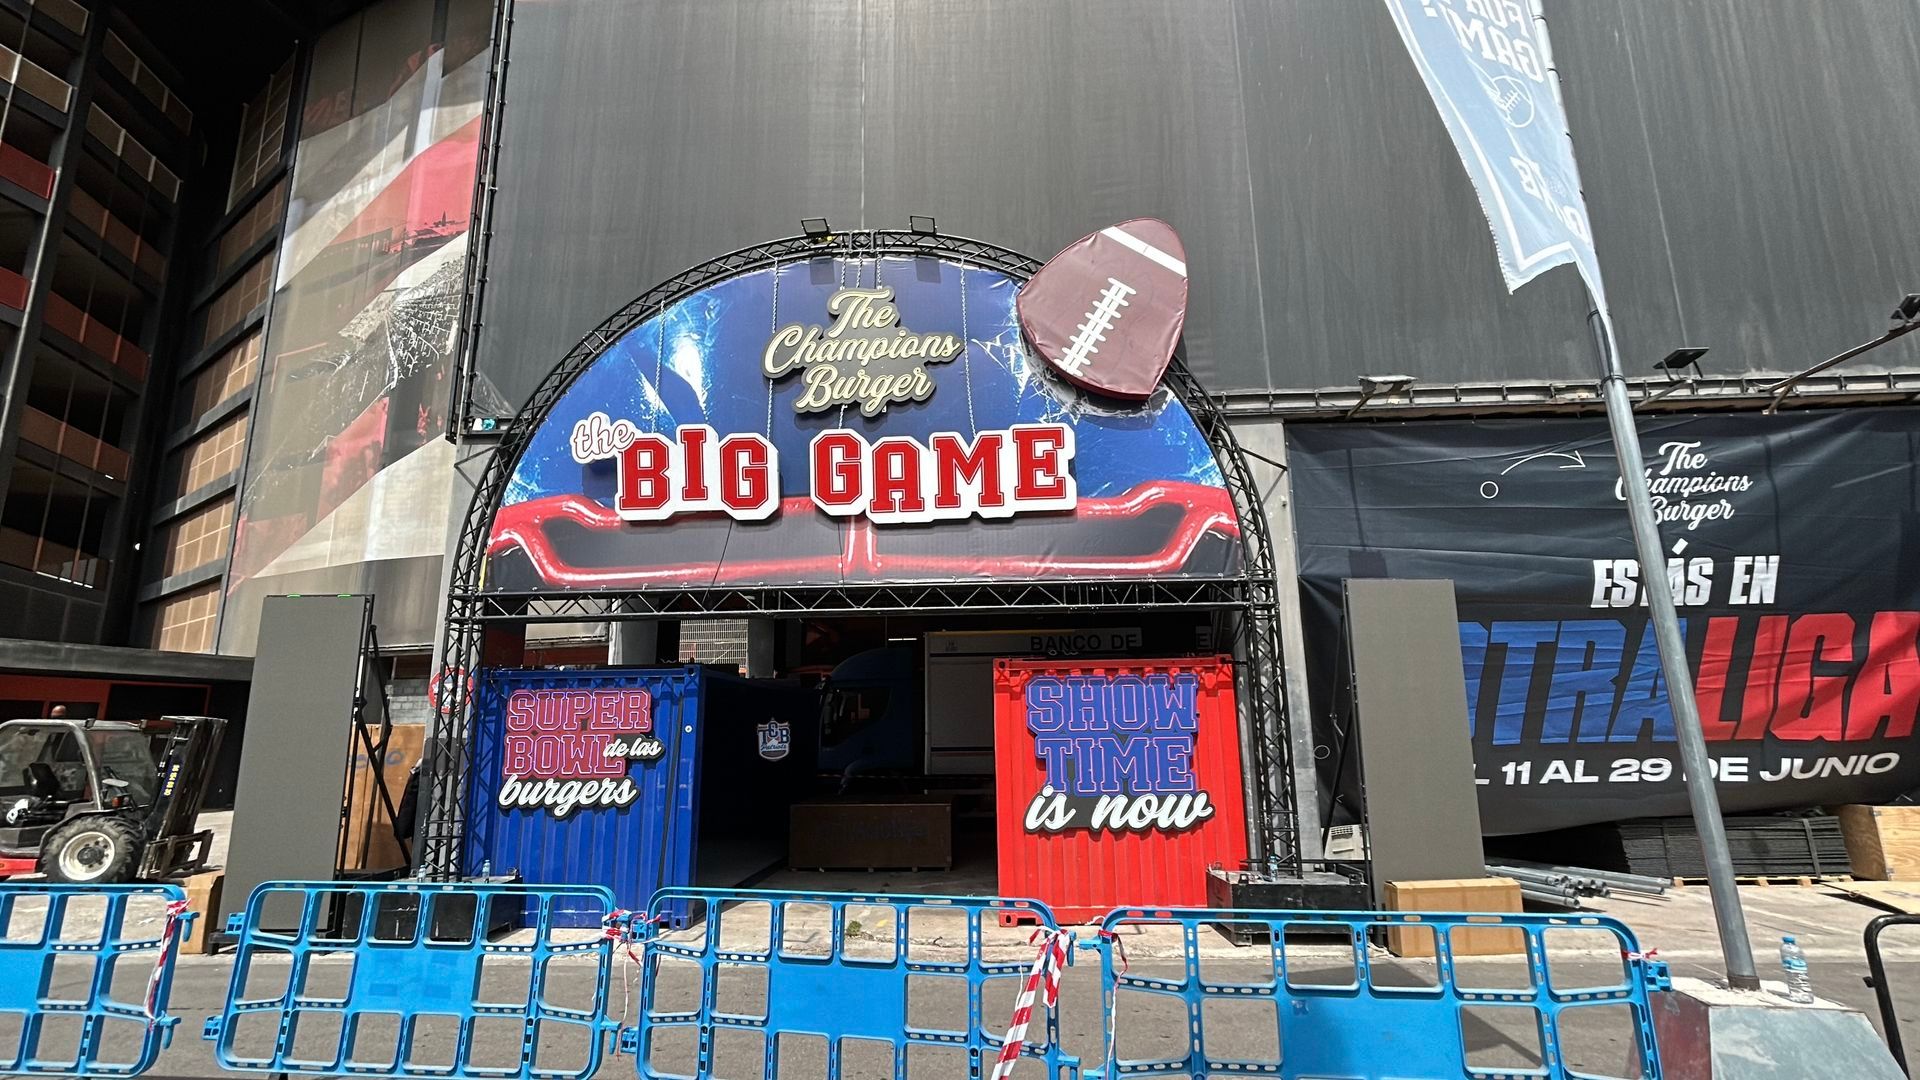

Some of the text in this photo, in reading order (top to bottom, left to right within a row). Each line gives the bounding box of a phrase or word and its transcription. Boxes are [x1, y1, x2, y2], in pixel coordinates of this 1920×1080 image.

[829, 287, 895, 337] The
[766, 327, 961, 373] Champions
[795, 368, 931, 412] Burger
[573, 417, 1067, 514] the BIG GAME
[1658, 441, 1708, 475] The
[1591, 538, 1780, 608] ESÁS EN
[1029, 634, 1138, 651] BANCO DE
[507, 689, 652, 731] SUPER
[1027, 676, 1197, 732] SHOW
[503, 734, 662, 776] BOWL de las
[1037, 736, 1194, 793] TIME
[1501, 761, 1531, 785] 11
[1539, 759, 1599, 785] AL
[1608, 758, 1673, 783] 29
[1759, 752, 1901, 781] JUNIO
[499, 773, 637, 817] burgers
[1025, 784, 1214, 830] is now
